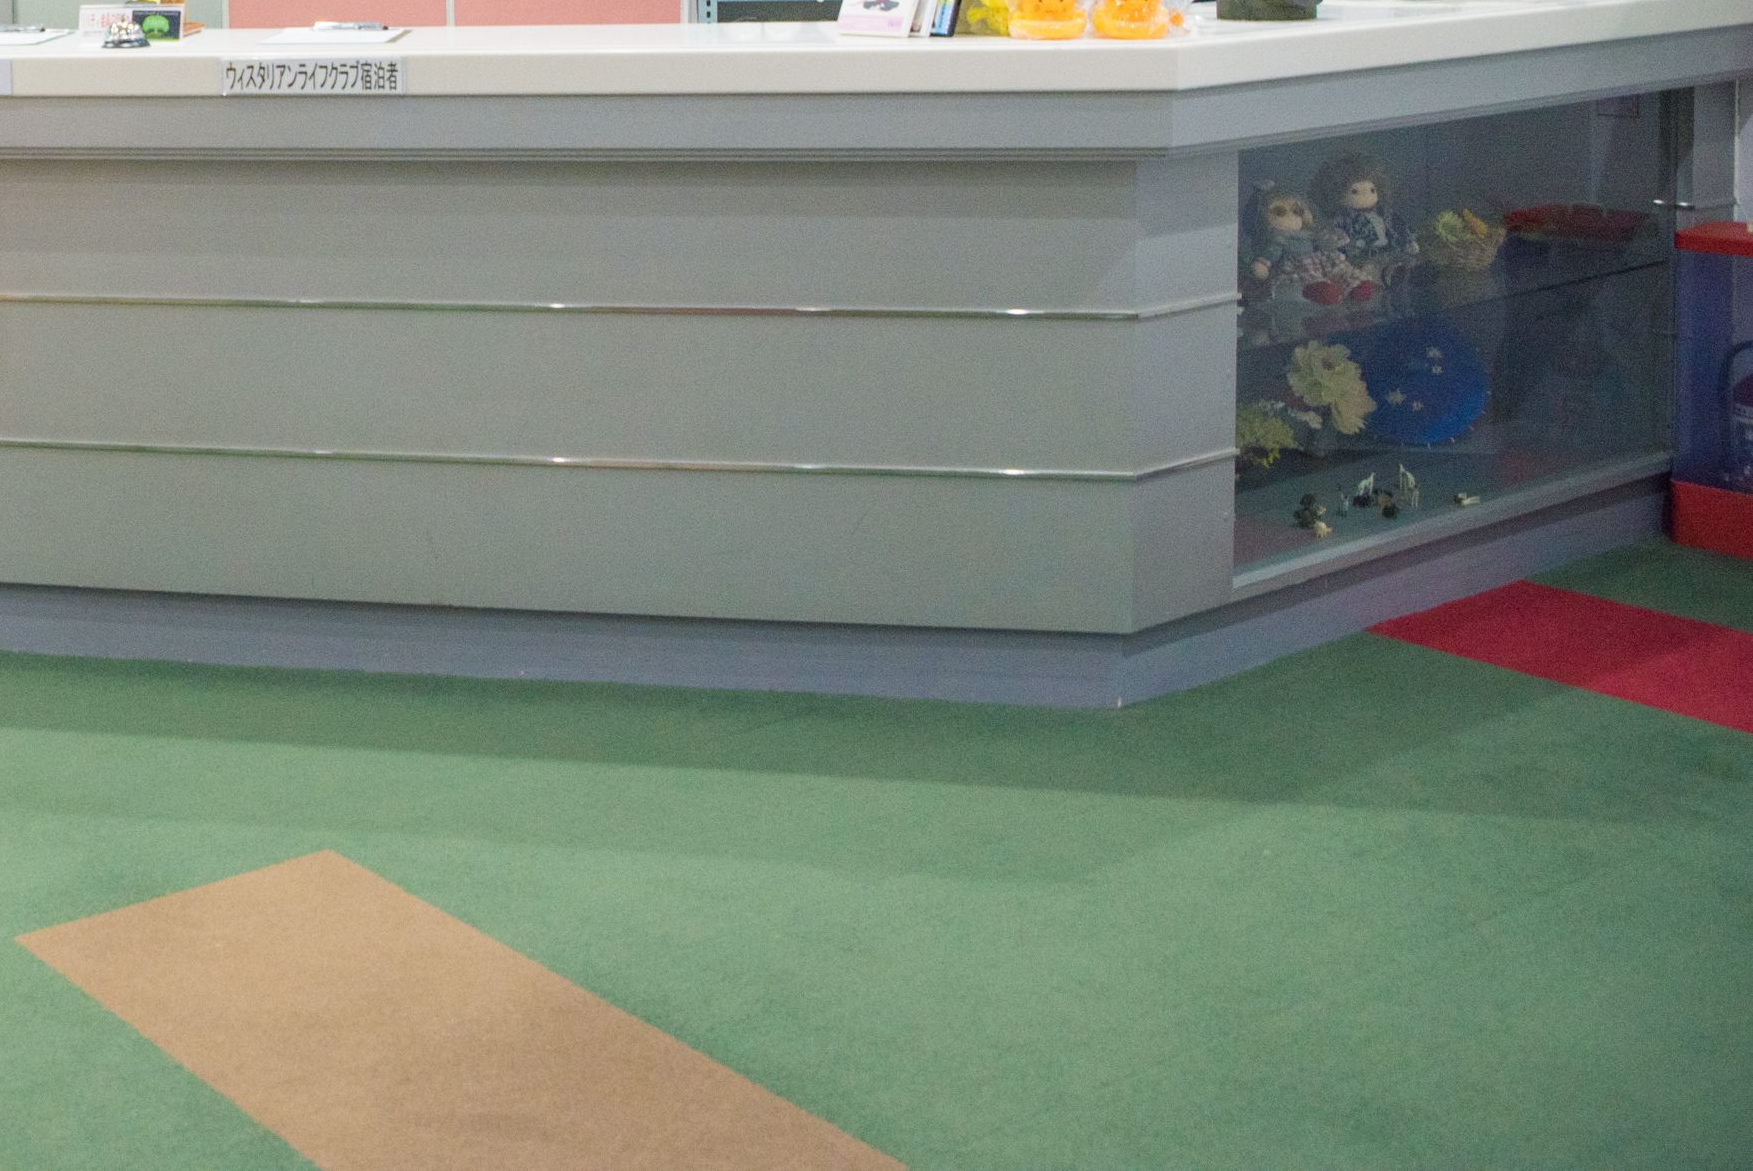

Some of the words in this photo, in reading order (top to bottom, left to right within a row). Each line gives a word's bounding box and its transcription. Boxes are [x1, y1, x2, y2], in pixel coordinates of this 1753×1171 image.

[225, 60, 399, 90] ウィスタリアンライフクラブ宿泊者
